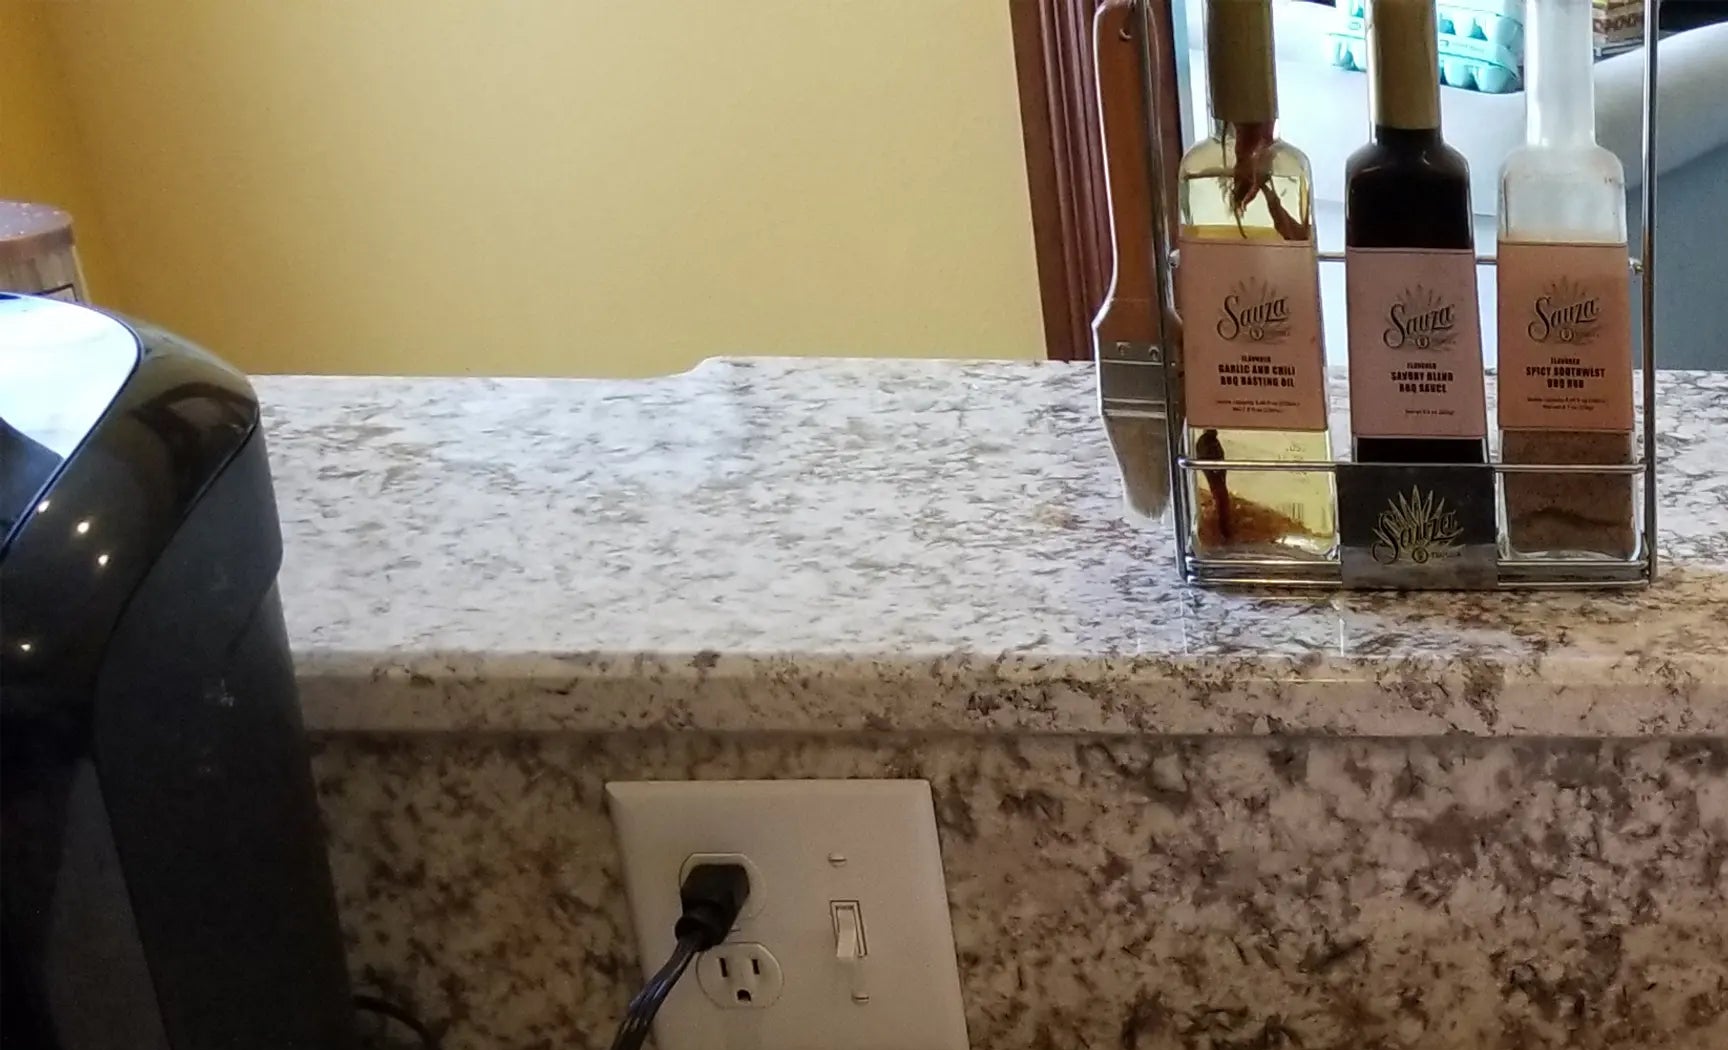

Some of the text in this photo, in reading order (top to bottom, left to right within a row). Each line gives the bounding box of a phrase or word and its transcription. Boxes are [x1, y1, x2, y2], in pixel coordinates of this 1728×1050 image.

[1217, 295, 1289, 340] Sauza
[1383, 303, 1455, 349] Sauza
[1527, 296, 1599, 342] Sauza
[1526, 366, 1551, 376] SPICY
